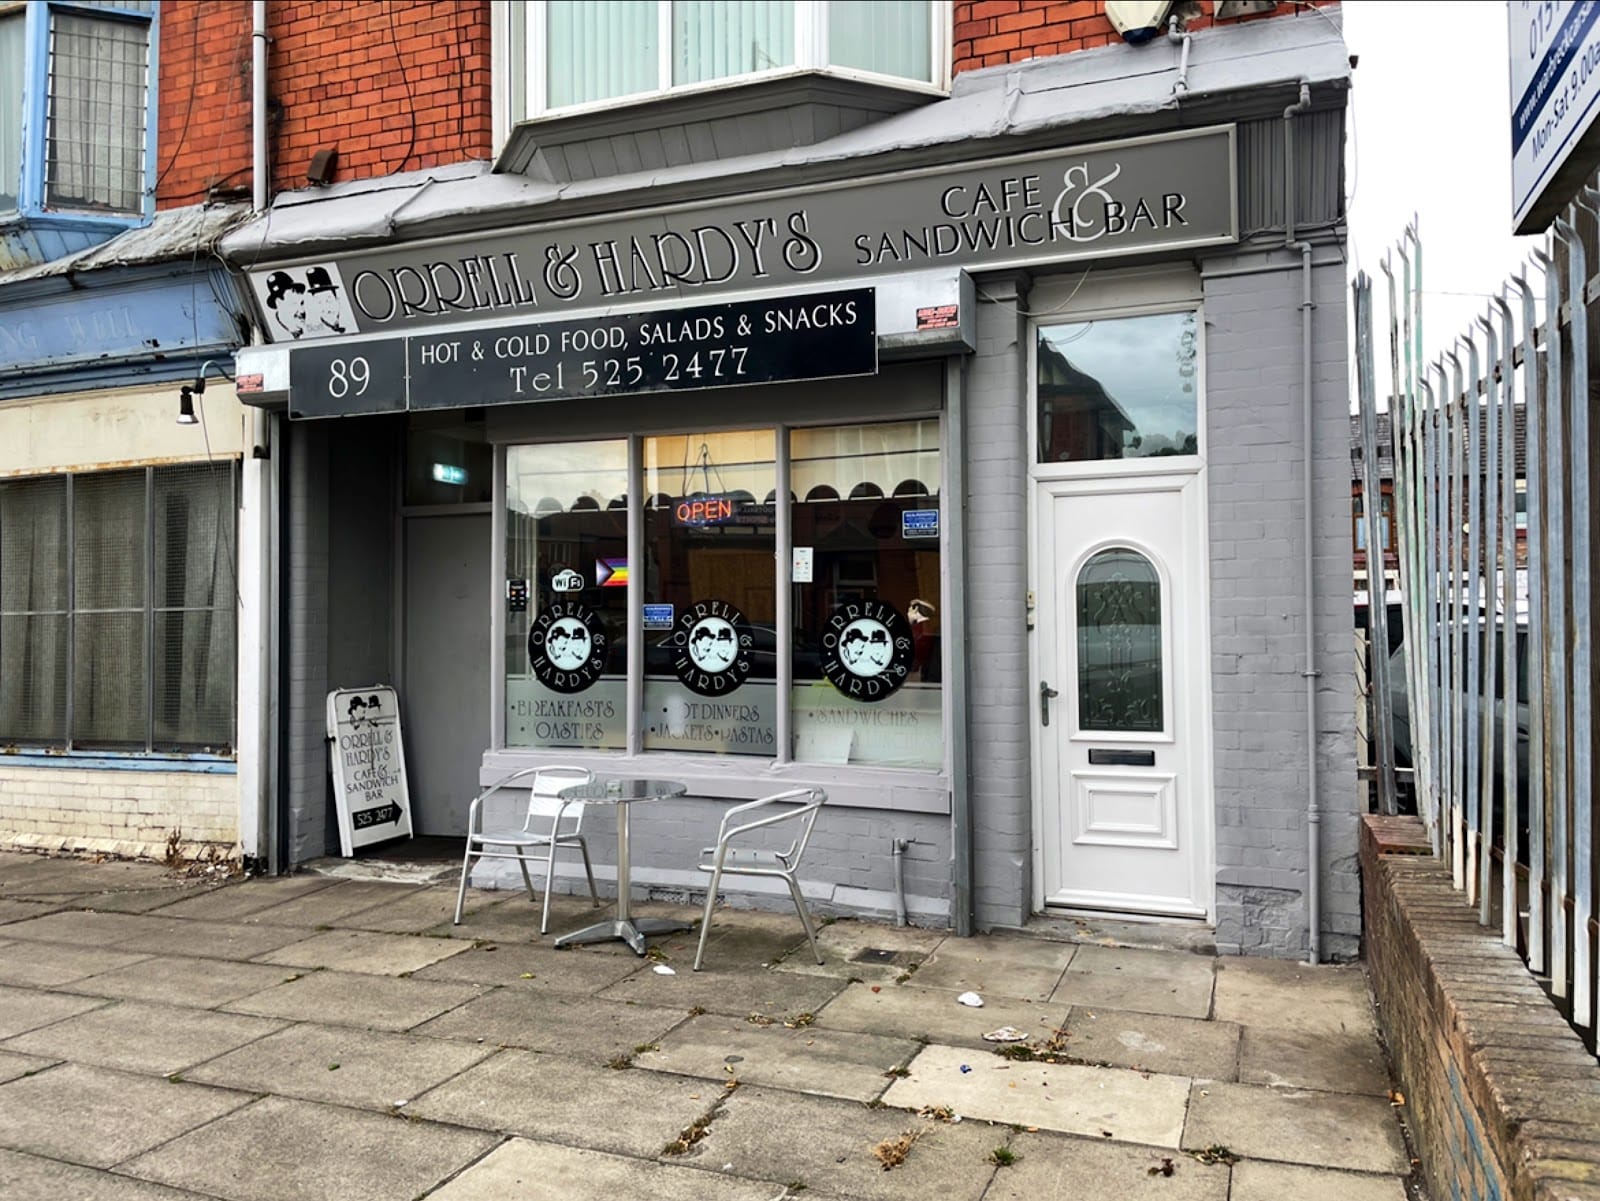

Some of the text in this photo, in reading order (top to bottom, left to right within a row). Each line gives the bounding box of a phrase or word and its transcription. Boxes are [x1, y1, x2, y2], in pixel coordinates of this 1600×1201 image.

[941, 162, 1121, 242] CAFE &
[854, 192, 1189, 267] SANDWICH BAR
[353, 209, 823, 323] ORRELL & HARDY'S
[421, 301, 857, 365] HOT & COLD FOOD, SALADS & SNACKS
[328, 356, 370, 398] 89
[509, 346, 749, 393] Tel 525 2477
[676, 499, 732, 521] OPEN
[532, 602, 606, 646] ORRELL &
[673, 601, 741, 646] ORRELL
[739, 633, 753, 648] &
[822, 601, 911, 651] ORRELL &
[701, 703, 761, 723] DINNERS
[341, 731, 383, 751] ORRELL
[346, 774, 399, 794] SANDWICH
[353, 768, 376, 781] CAFE
[365, 789, 384, 802] BAR
[357, 811, 373, 826] 525
